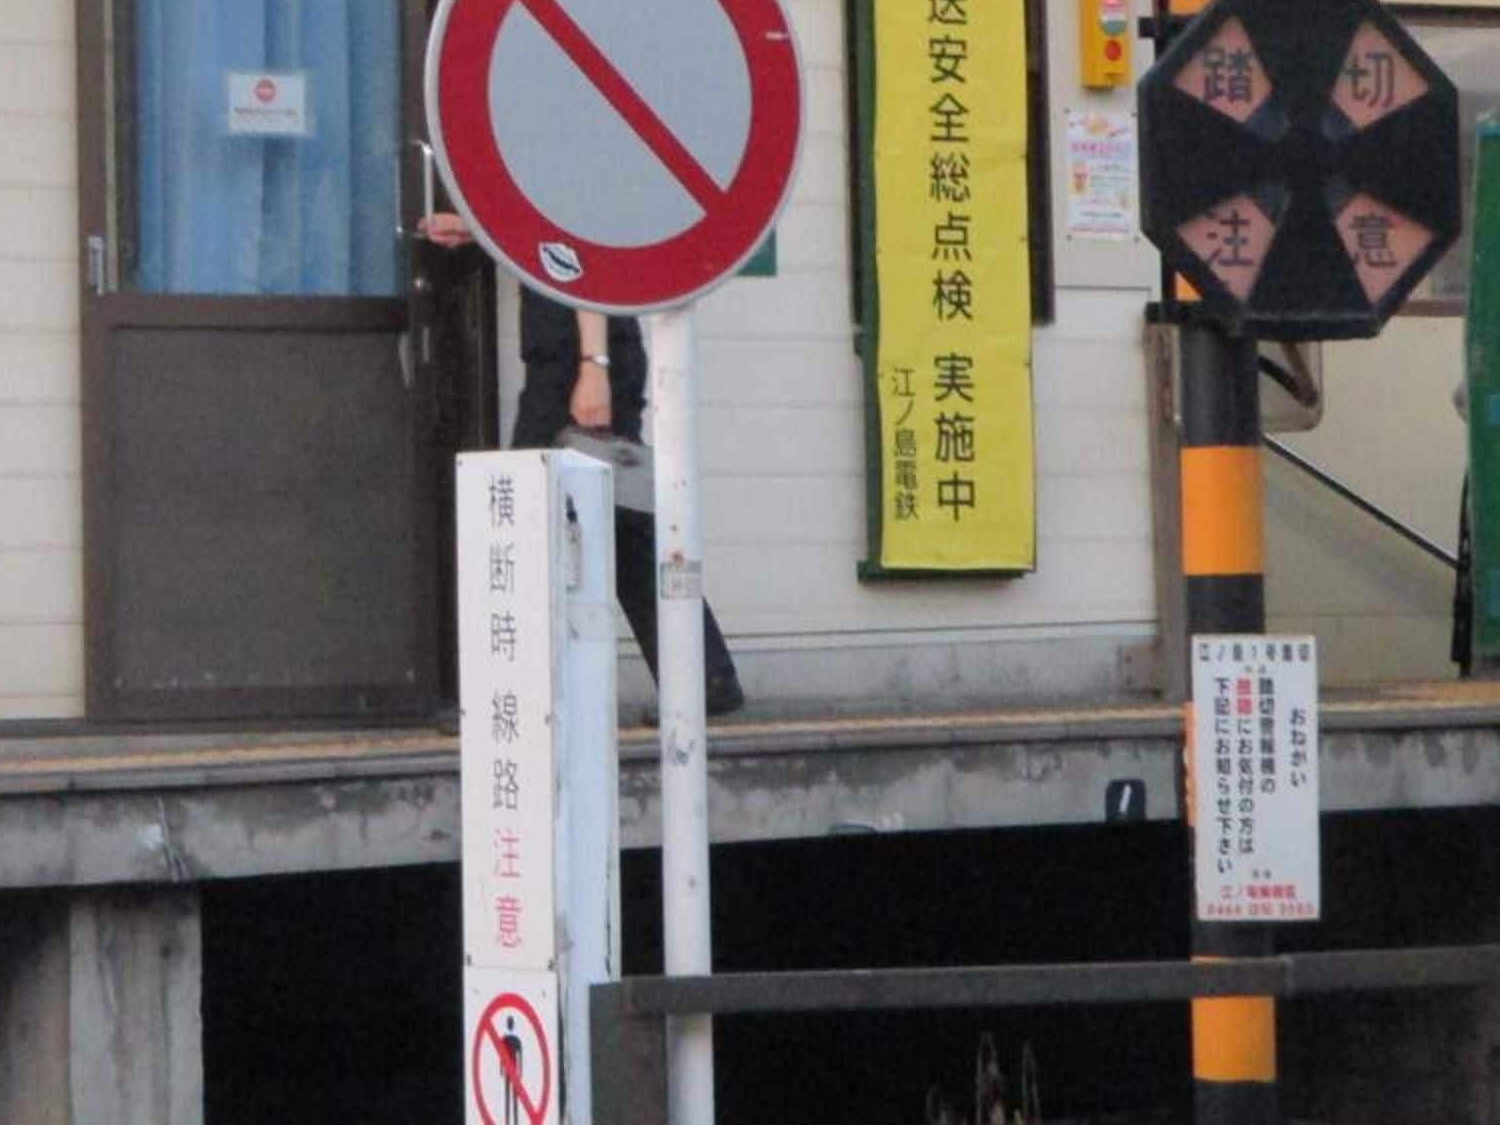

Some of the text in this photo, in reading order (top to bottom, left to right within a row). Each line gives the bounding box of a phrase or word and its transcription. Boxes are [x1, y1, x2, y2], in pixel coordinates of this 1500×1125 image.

[891, 367, 920, 522] 江ノ島電鉄
[932, 353, 976, 523] 実施中
[488, 473, 523, 949] 横断時線路注意
